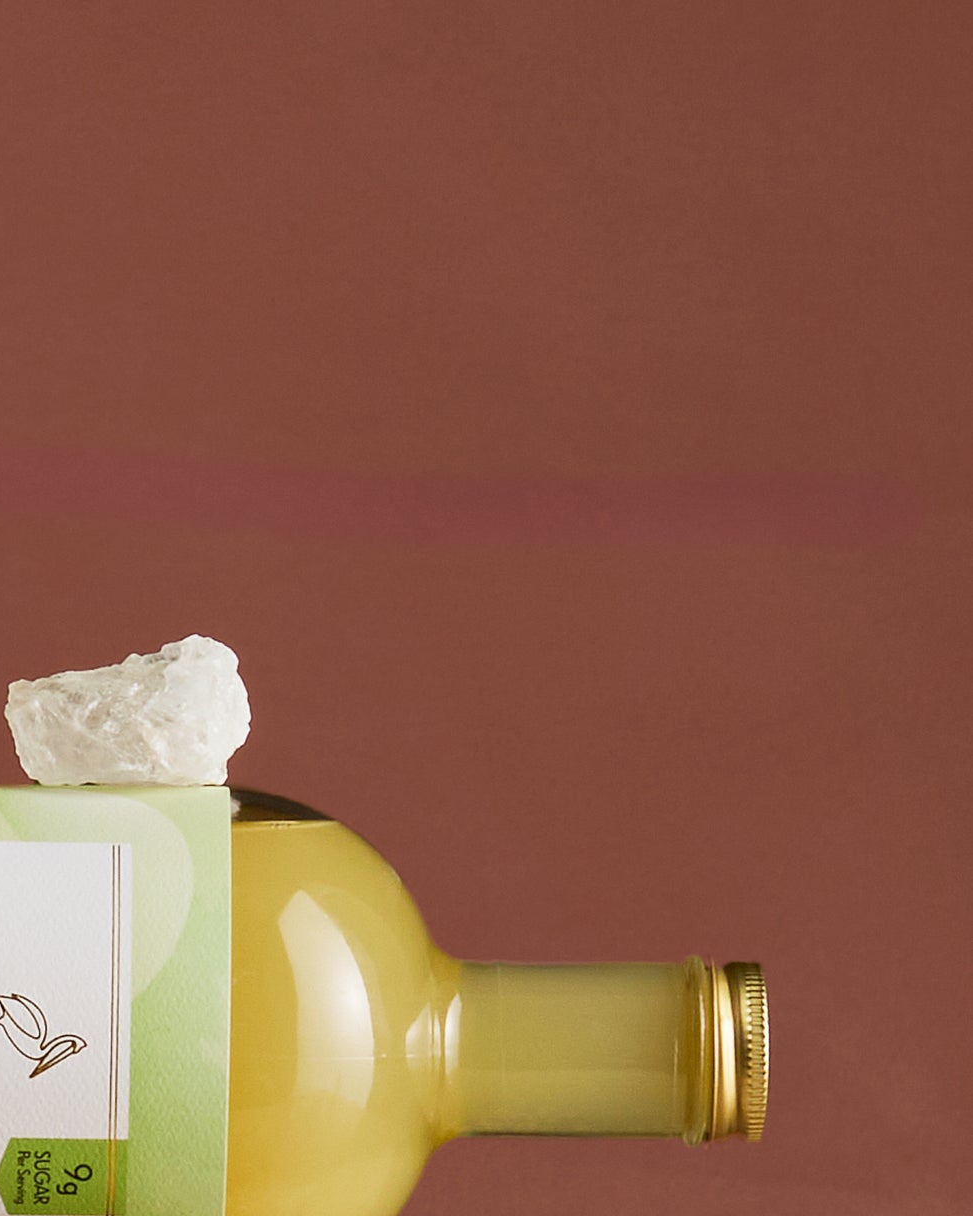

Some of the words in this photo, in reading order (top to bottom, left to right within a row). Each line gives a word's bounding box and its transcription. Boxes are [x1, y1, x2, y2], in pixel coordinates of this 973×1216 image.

[17, 1150, 31, 1167] Per
[13, 1169, 31, 1204] Serving
[33, 1151, 51, 1205] SUGAR
[56, 1164, 93, 1195] 9g
